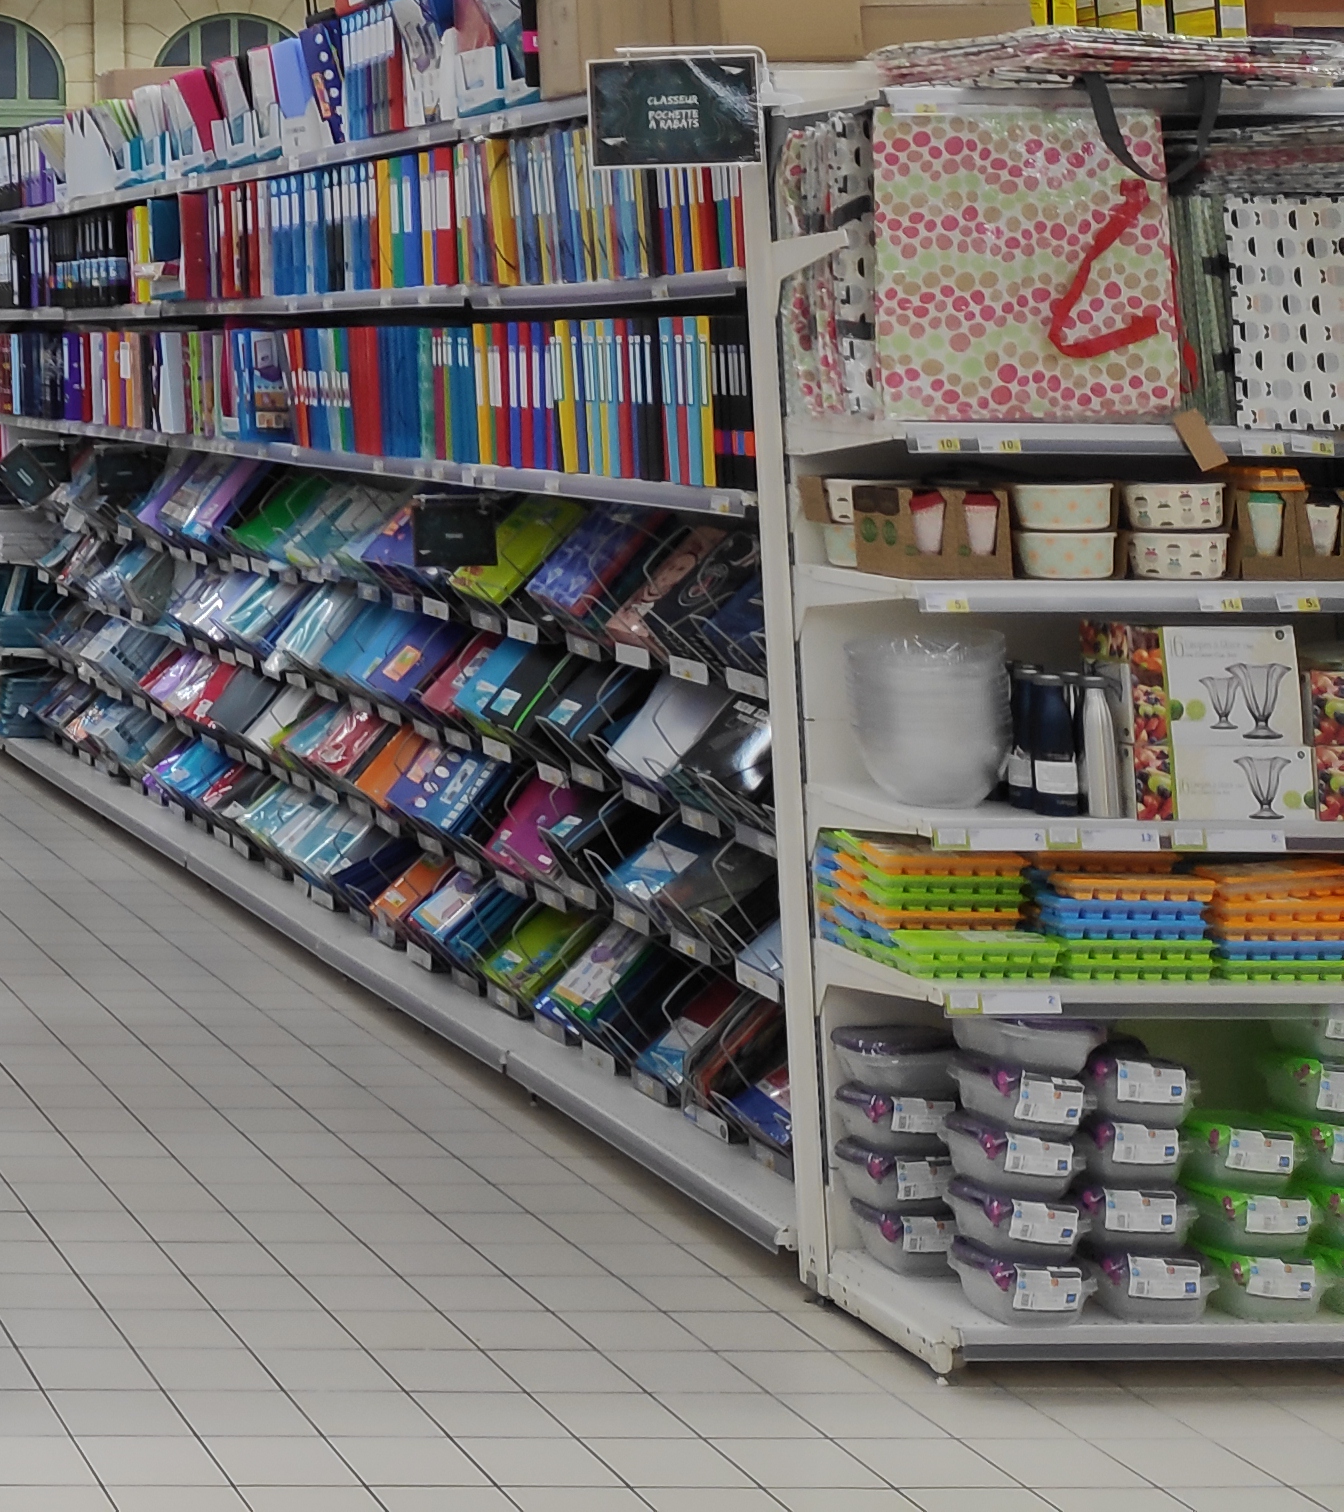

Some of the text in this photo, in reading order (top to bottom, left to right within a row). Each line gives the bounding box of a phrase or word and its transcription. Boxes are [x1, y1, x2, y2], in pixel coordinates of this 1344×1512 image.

[647, 95, 700, 106] CLASSEUR
[648, 109, 699, 120] POCHETTE
[660, 118, 700, 130] RABATS
